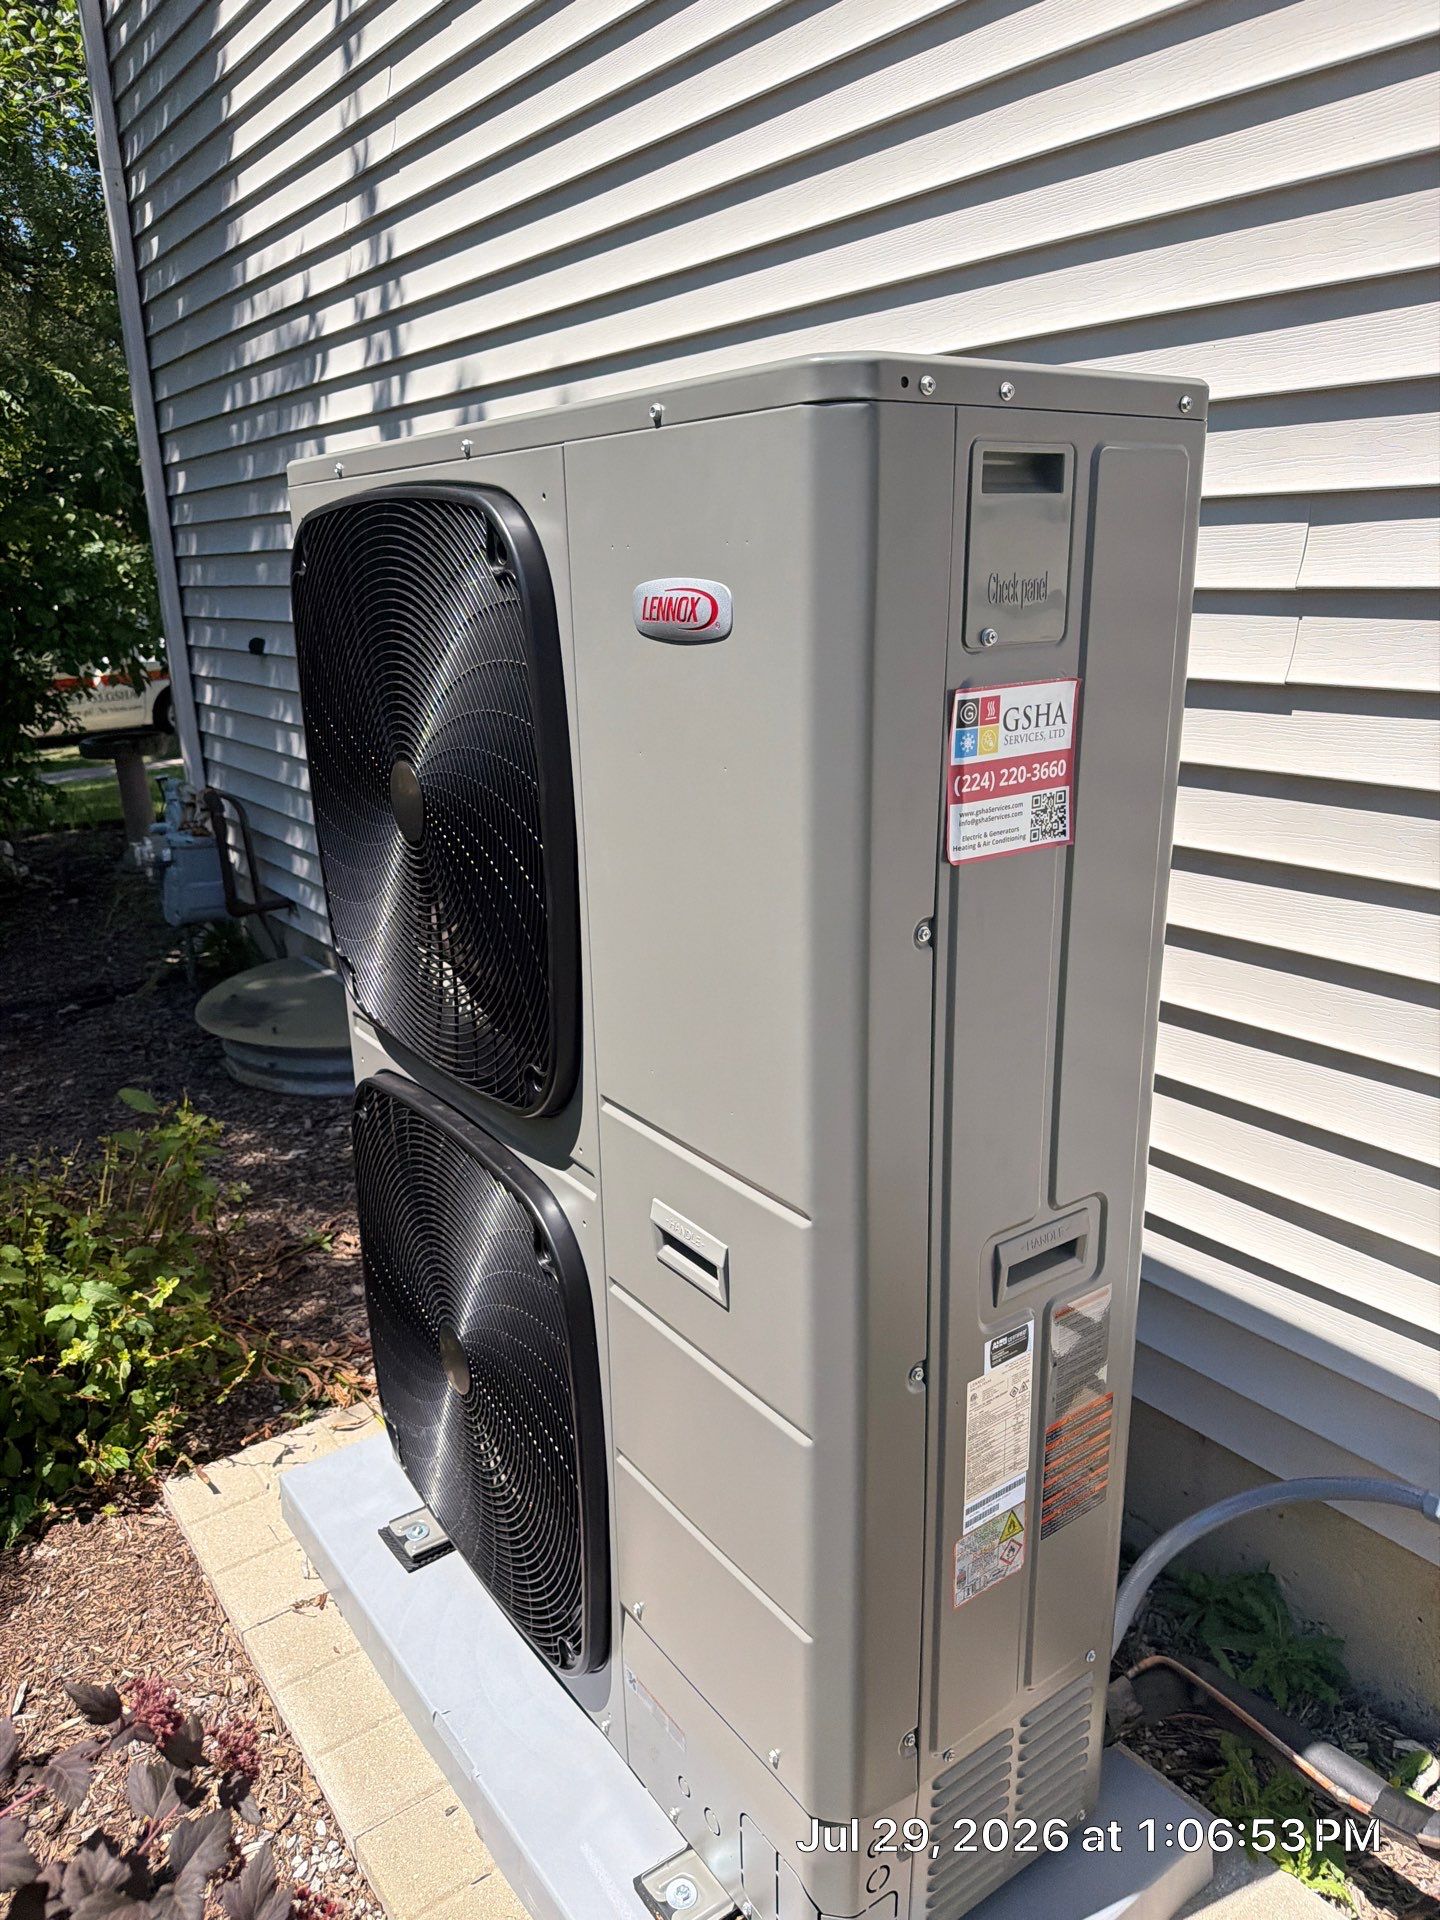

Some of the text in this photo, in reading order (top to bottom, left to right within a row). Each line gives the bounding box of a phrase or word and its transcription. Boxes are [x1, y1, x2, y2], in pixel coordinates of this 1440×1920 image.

[987, 571, 1048, 610] Check panel
[642, 596, 701, 622] LENNOX
[1003, 701, 1067, 732] GSHA
[954, 759, 1067, 797] (224) 220-3660
[952, 842, 977, 853] Heating
[983, 839, 991, 848] Air
[992, 833, 1027, 847] Conditioning
[962, 826, 1020, 843] Electric & Generators
